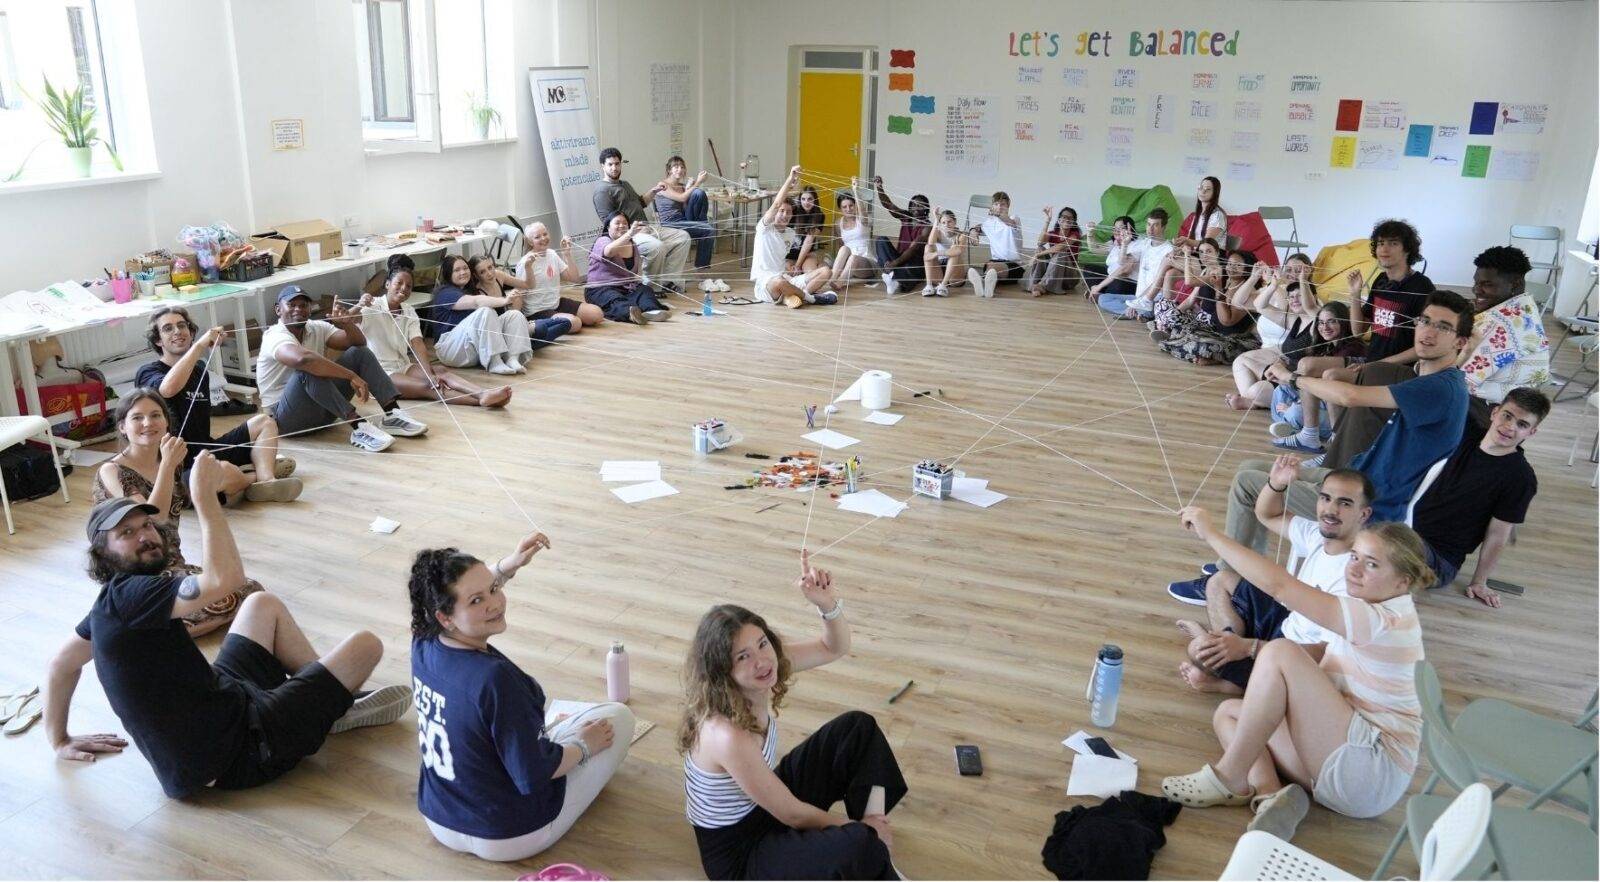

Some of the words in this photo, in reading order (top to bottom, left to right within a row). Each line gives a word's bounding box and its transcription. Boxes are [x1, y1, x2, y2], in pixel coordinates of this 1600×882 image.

[1075, 31, 1112, 57] get
[1114, 79, 1134, 87] LIFE
[547, 85, 566, 104] MC
[1153, 94, 1162, 129] FREE
[1191, 105, 1210, 117] DICE
[1288, 112, 1314, 121] BUBBLE
[550, 135, 597, 150] aktiviramo
[1286, 134, 1308, 142] LAST
[1285, 143, 1309, 153] WORDS
[564, 153, 589, 167] mlade
[559, 170, 601, 190] potenciale
[413, 676, 447, 725] EST.
